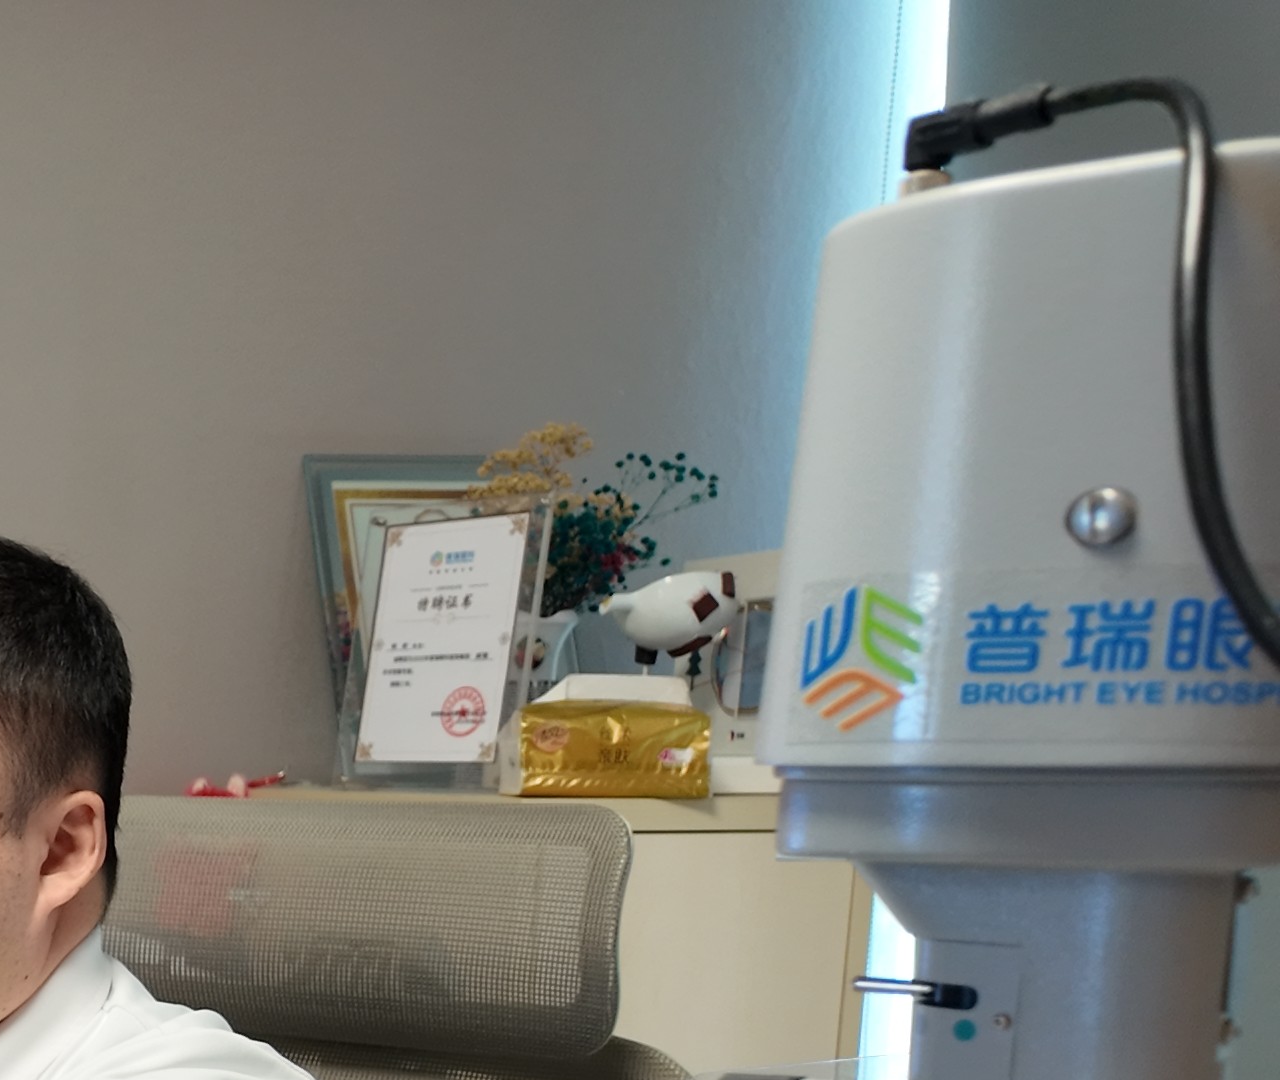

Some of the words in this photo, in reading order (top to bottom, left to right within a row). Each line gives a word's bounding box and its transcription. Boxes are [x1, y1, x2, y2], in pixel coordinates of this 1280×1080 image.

[964, 598, 1254, 674] 普瑞眼
[960, 682, 1091, 706] BRIGHT
[1097, 681, 1164, 705] EYE
[1176, 681, 1280, 705] HOSP
